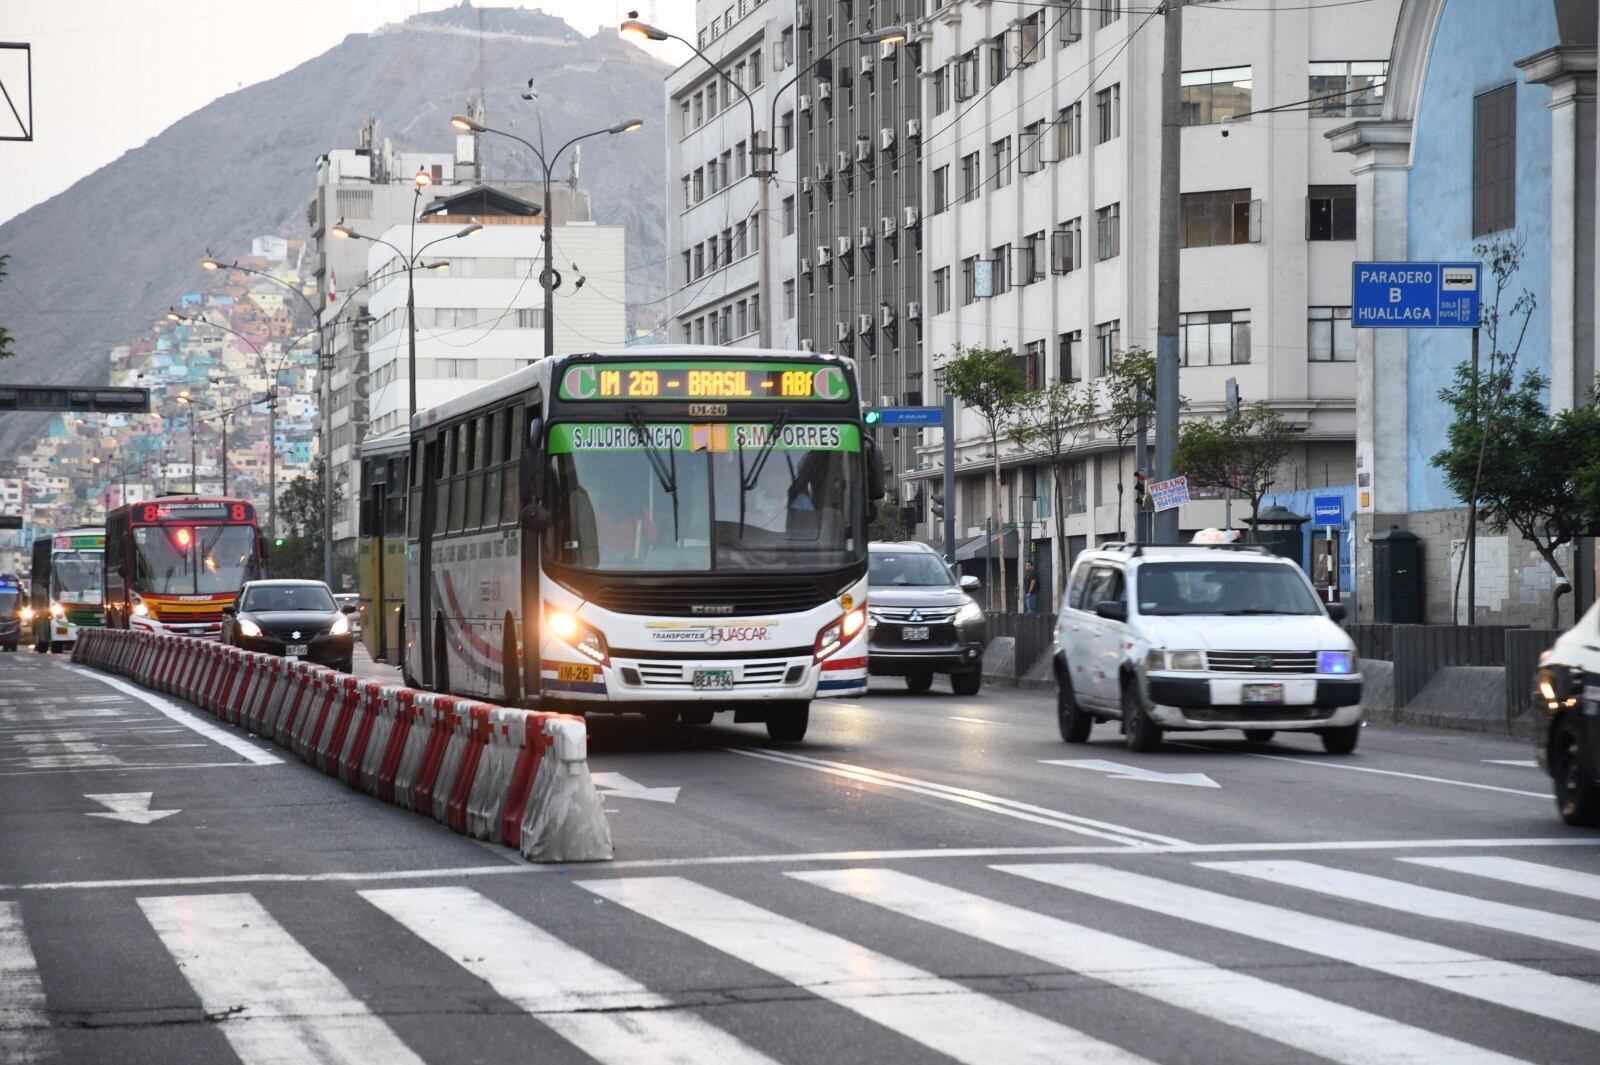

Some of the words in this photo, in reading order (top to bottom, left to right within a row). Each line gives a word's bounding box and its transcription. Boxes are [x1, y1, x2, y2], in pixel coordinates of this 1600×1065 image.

[1361, 271, 1432, 283] PARADERO
[1390, 288, 1402, 302] B
[1359, 307, 1432, 319] HUALLAGA
[688, 371, 752, 396] BRASIL
[143, 505, 157, 522] 8
[232, 503, 246, 521] 8
[711, 627, 766, 641] HUASCAR
[560, 665, 589, 681] IM-26
